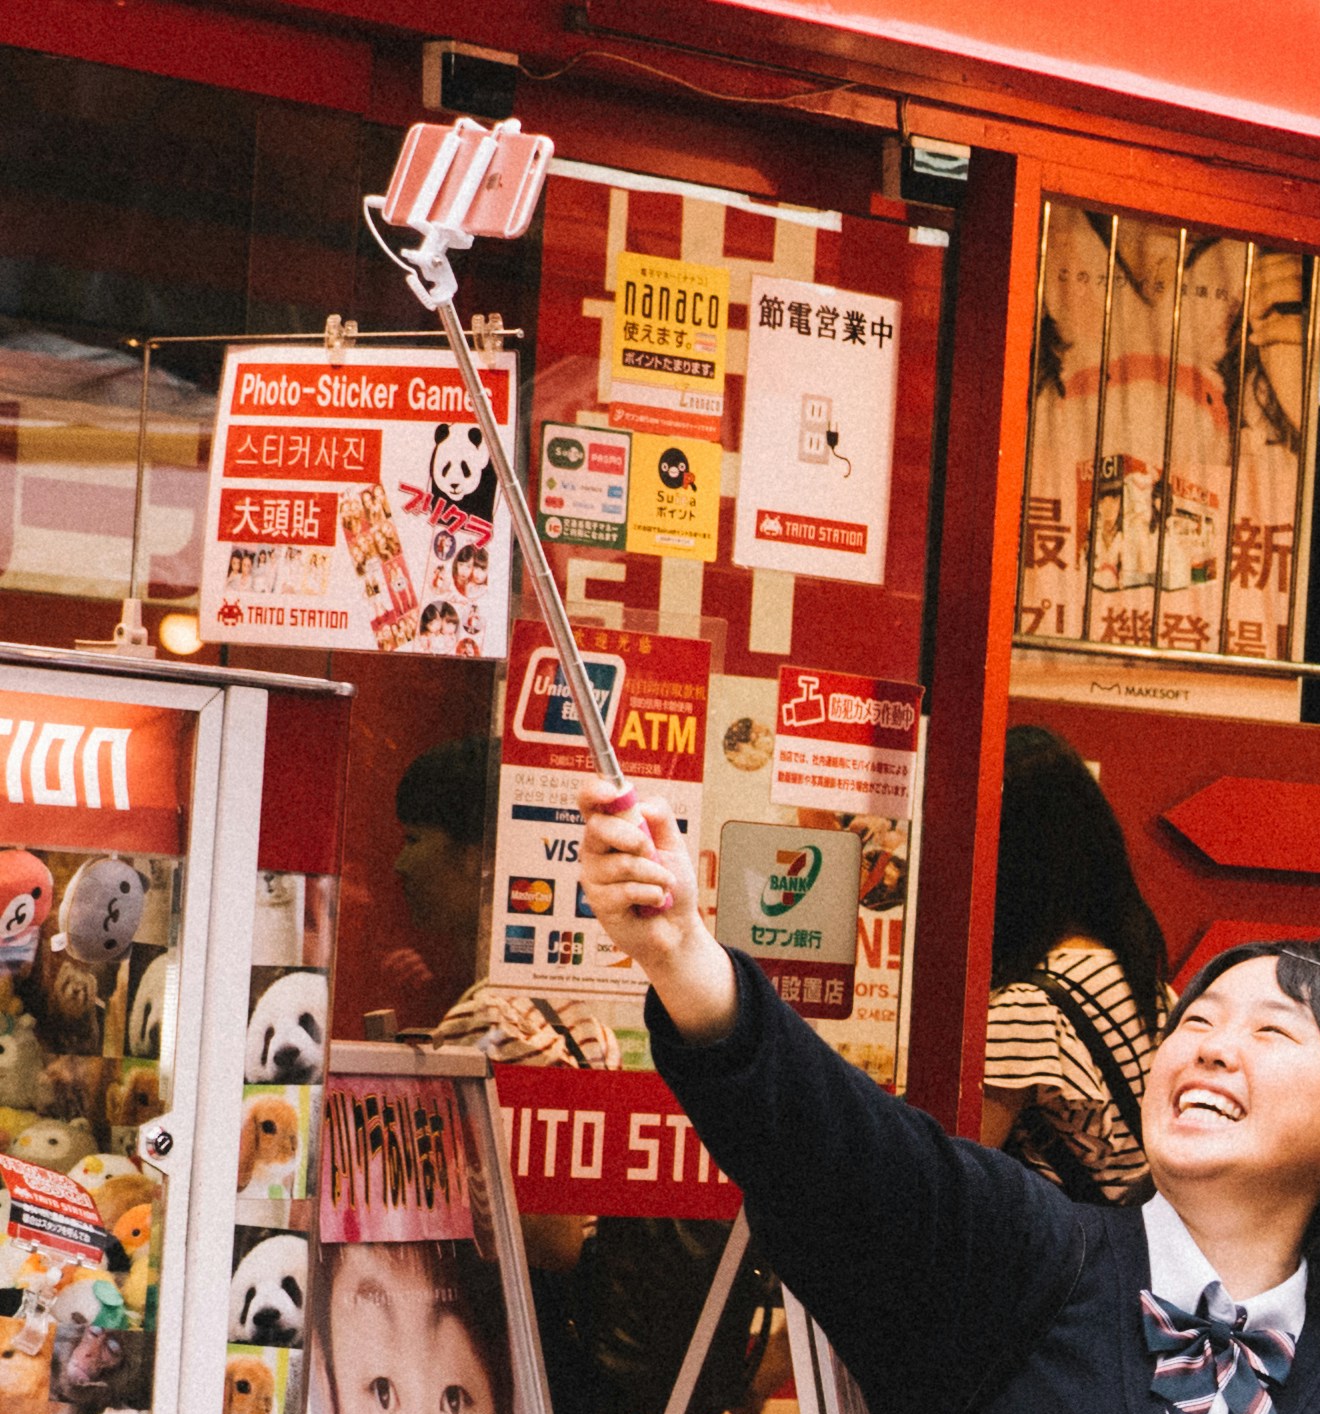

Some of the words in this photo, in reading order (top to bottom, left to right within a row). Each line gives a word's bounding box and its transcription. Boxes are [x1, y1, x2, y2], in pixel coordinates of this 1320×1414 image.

[624, 281, 720, 329] nanaco
[623, 321, 692, 350] 使えます。
[758, 294, 893, 349] 節電営業中
[624, 351, 715, 378] ポイントたまります。
[240, 373, 399, 410] Photo-Sticker
[235, 434, 365, 471] 스티커사진
[232, 497, 321, 539] 大頭貼
[399, 482, 494, 549] プリクラ
[785, 521, 816, 540] TAITO
[819, 524, 863, 547] STATION
[1231, 517, 1294, 592] 新
[247, 606, 284, 626] TAITO
[290, 607, 348, 629] STATION
[1124, 685, 1191, 701] MAKESOFT
[618, 710, 697, 755] ATM
[541, 838, 581, 863] VIS
[770, 874, 811, 892] BANK
[548, 941, 584, 955] JCB
[751, 924, 823, 950] セブン銀行
